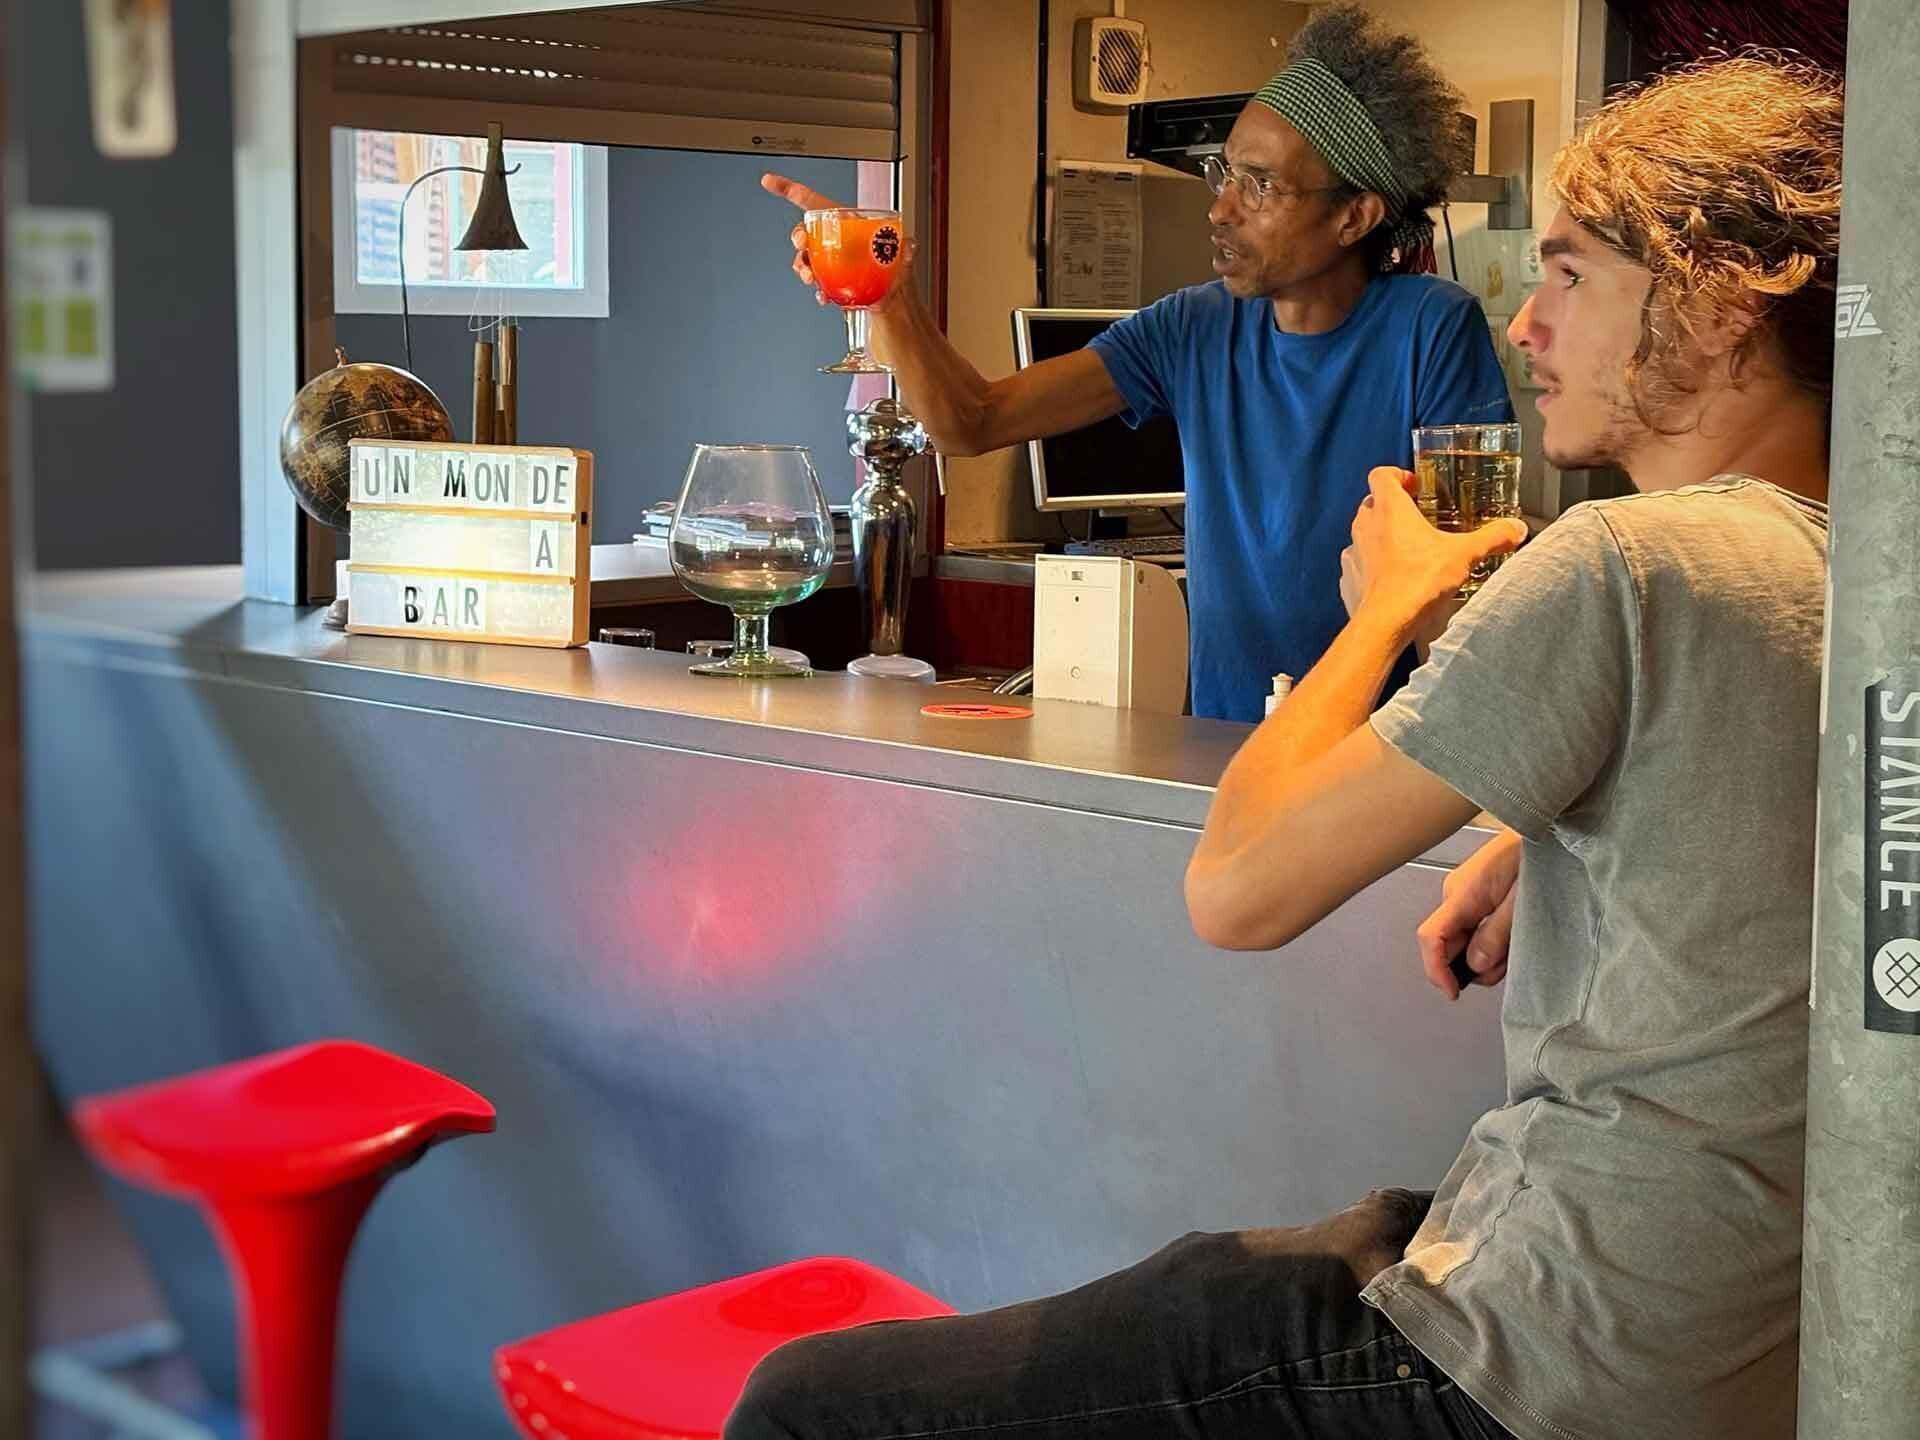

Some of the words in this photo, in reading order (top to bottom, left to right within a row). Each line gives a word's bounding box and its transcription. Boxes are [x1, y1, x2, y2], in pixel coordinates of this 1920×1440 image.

[363, 456, 410, 497] UN
[535, 529, 553, 569] A
[404, 585, 480, 626] BAR
